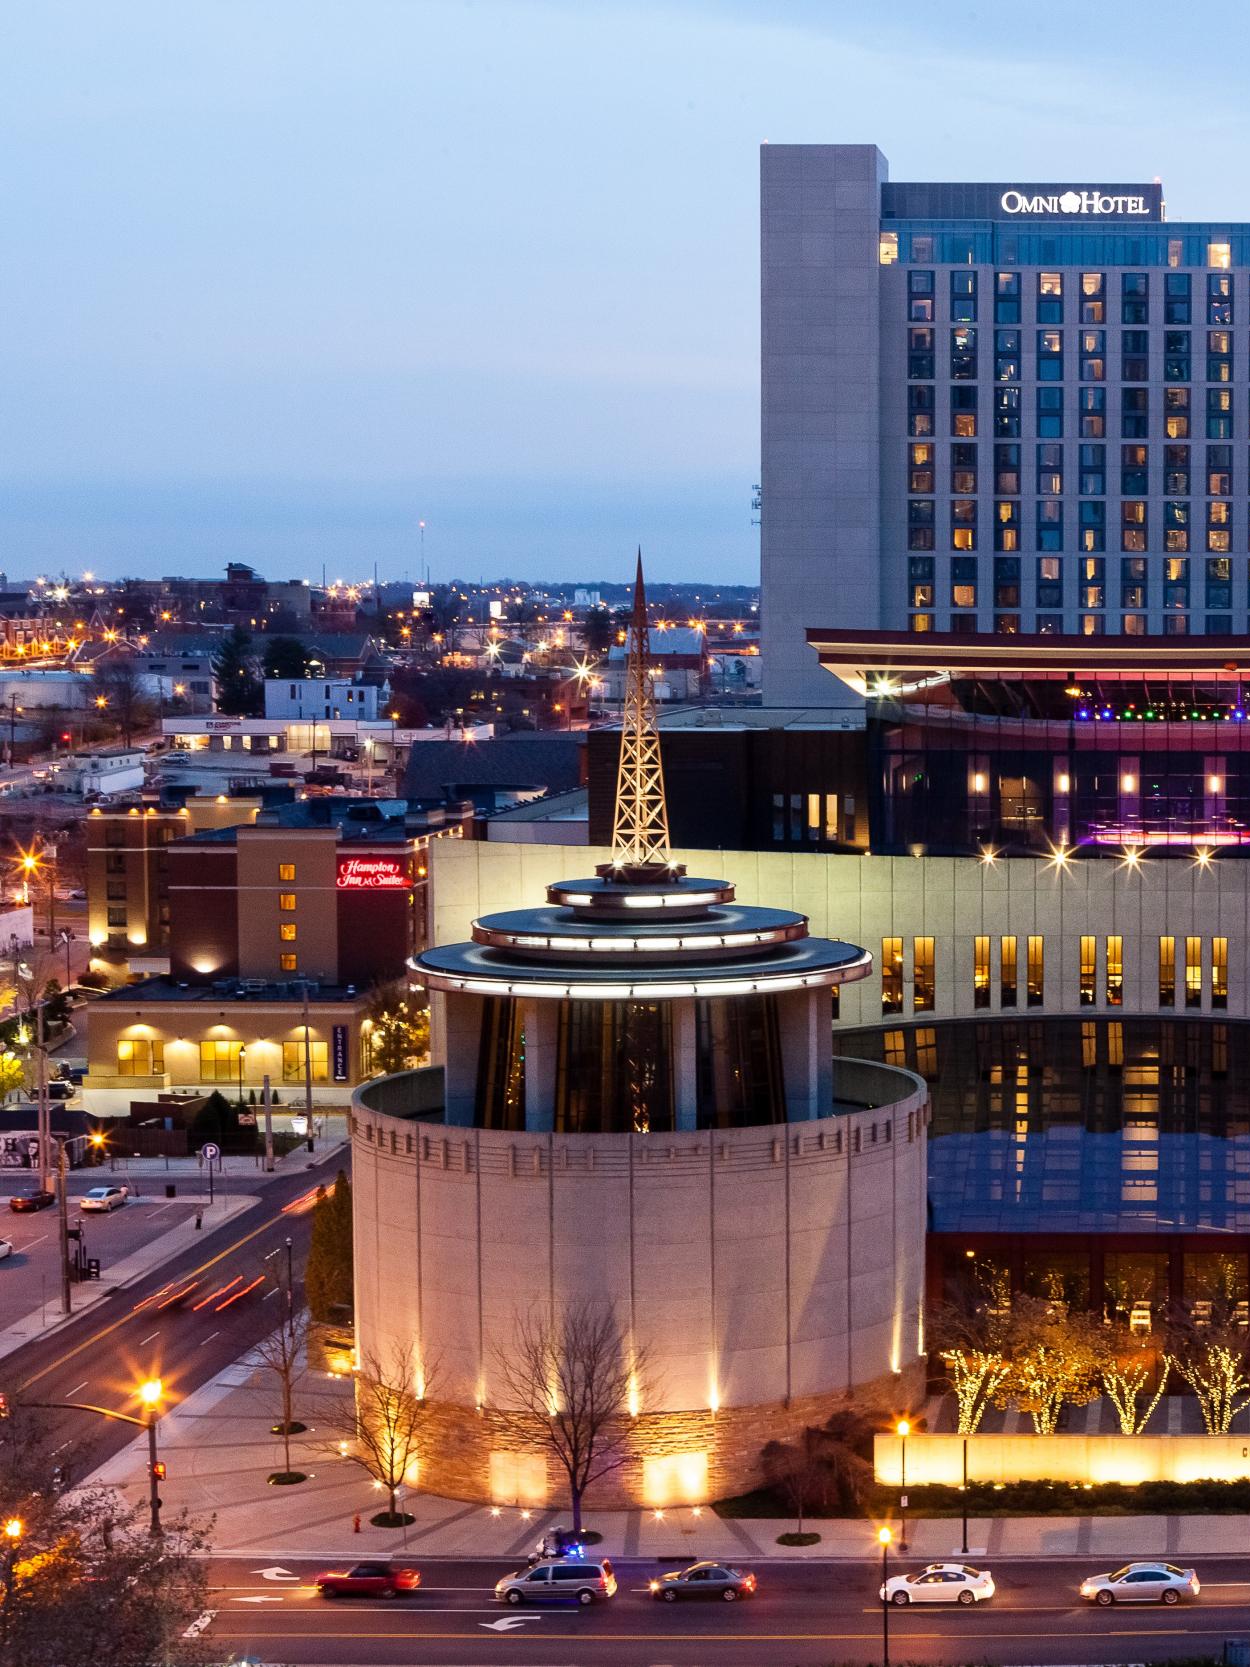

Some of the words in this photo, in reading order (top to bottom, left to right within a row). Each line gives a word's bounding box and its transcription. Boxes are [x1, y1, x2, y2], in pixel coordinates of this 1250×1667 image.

[1001, 191, 1059, 214] OMNI
[1079, 191, 1149, 214] HOTEL
[340, 860, 399, 874] Hampton
[337, 875, 363, 887] Inn
[373, 874, 404, 886] Suites
[206, 1146, 216, 1158] P
